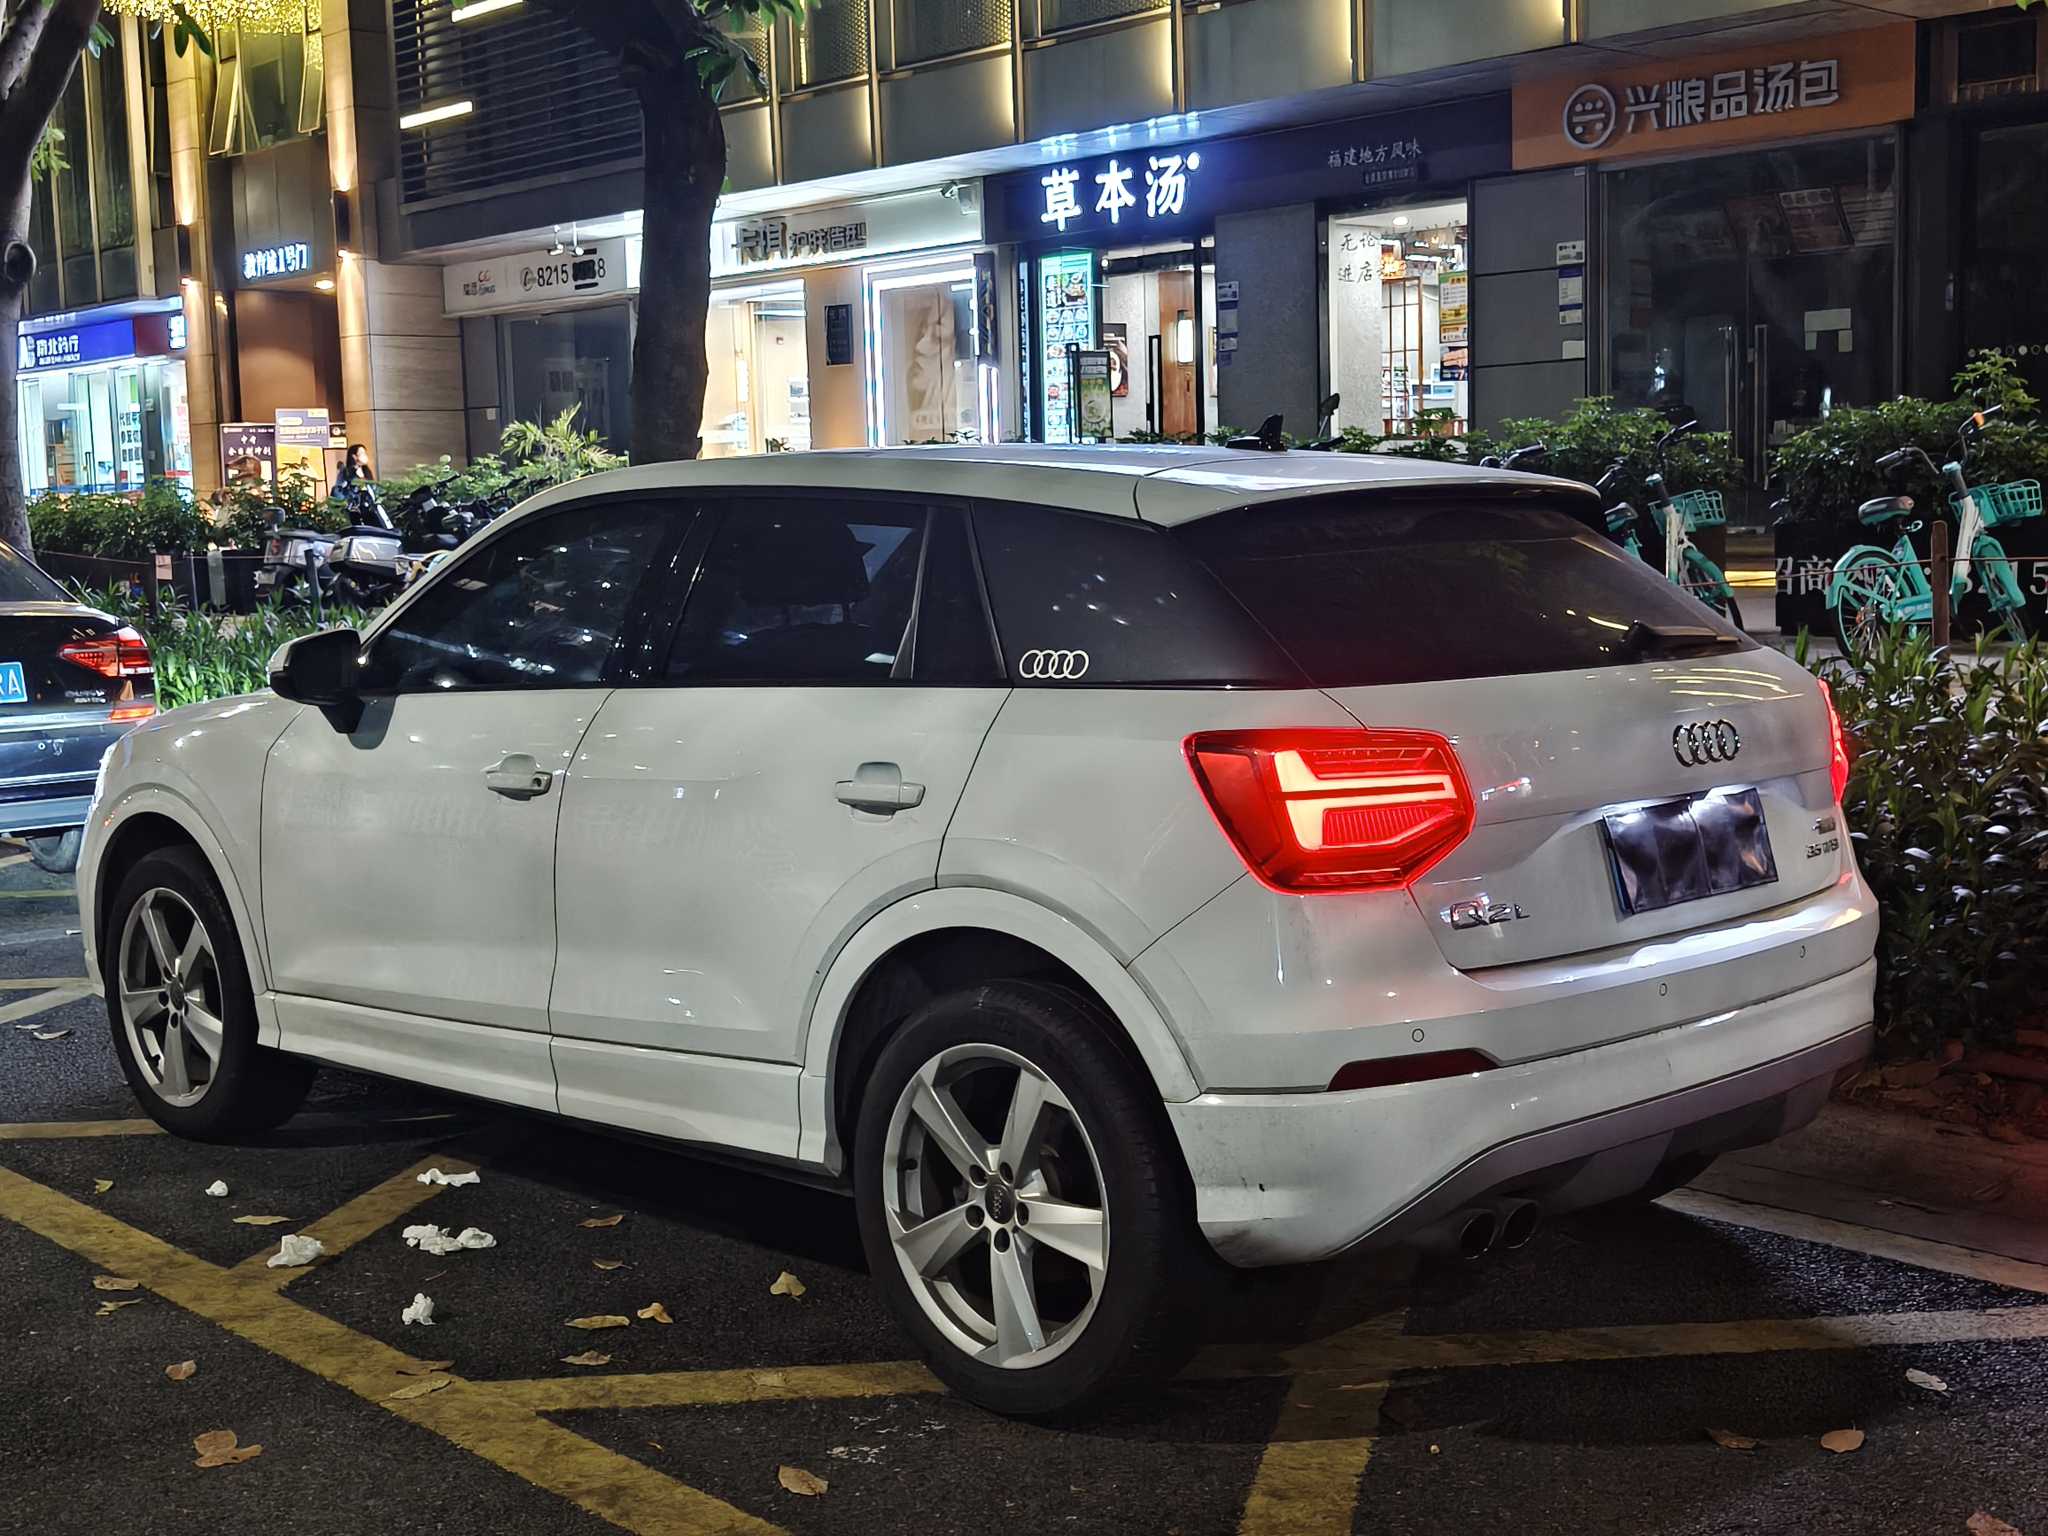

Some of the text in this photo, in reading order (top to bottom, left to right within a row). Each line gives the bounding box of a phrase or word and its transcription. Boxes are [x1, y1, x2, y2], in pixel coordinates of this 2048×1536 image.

[1625, 58, 1839, 134] 兴粮品汤包
[1328, 136, 1422, 168] 福建地方风味
[1041, 153, 1187, 232] 草本汤
[537, 258, 606, 287] 82158
[1450, 900, 1530, 930] Q2L
